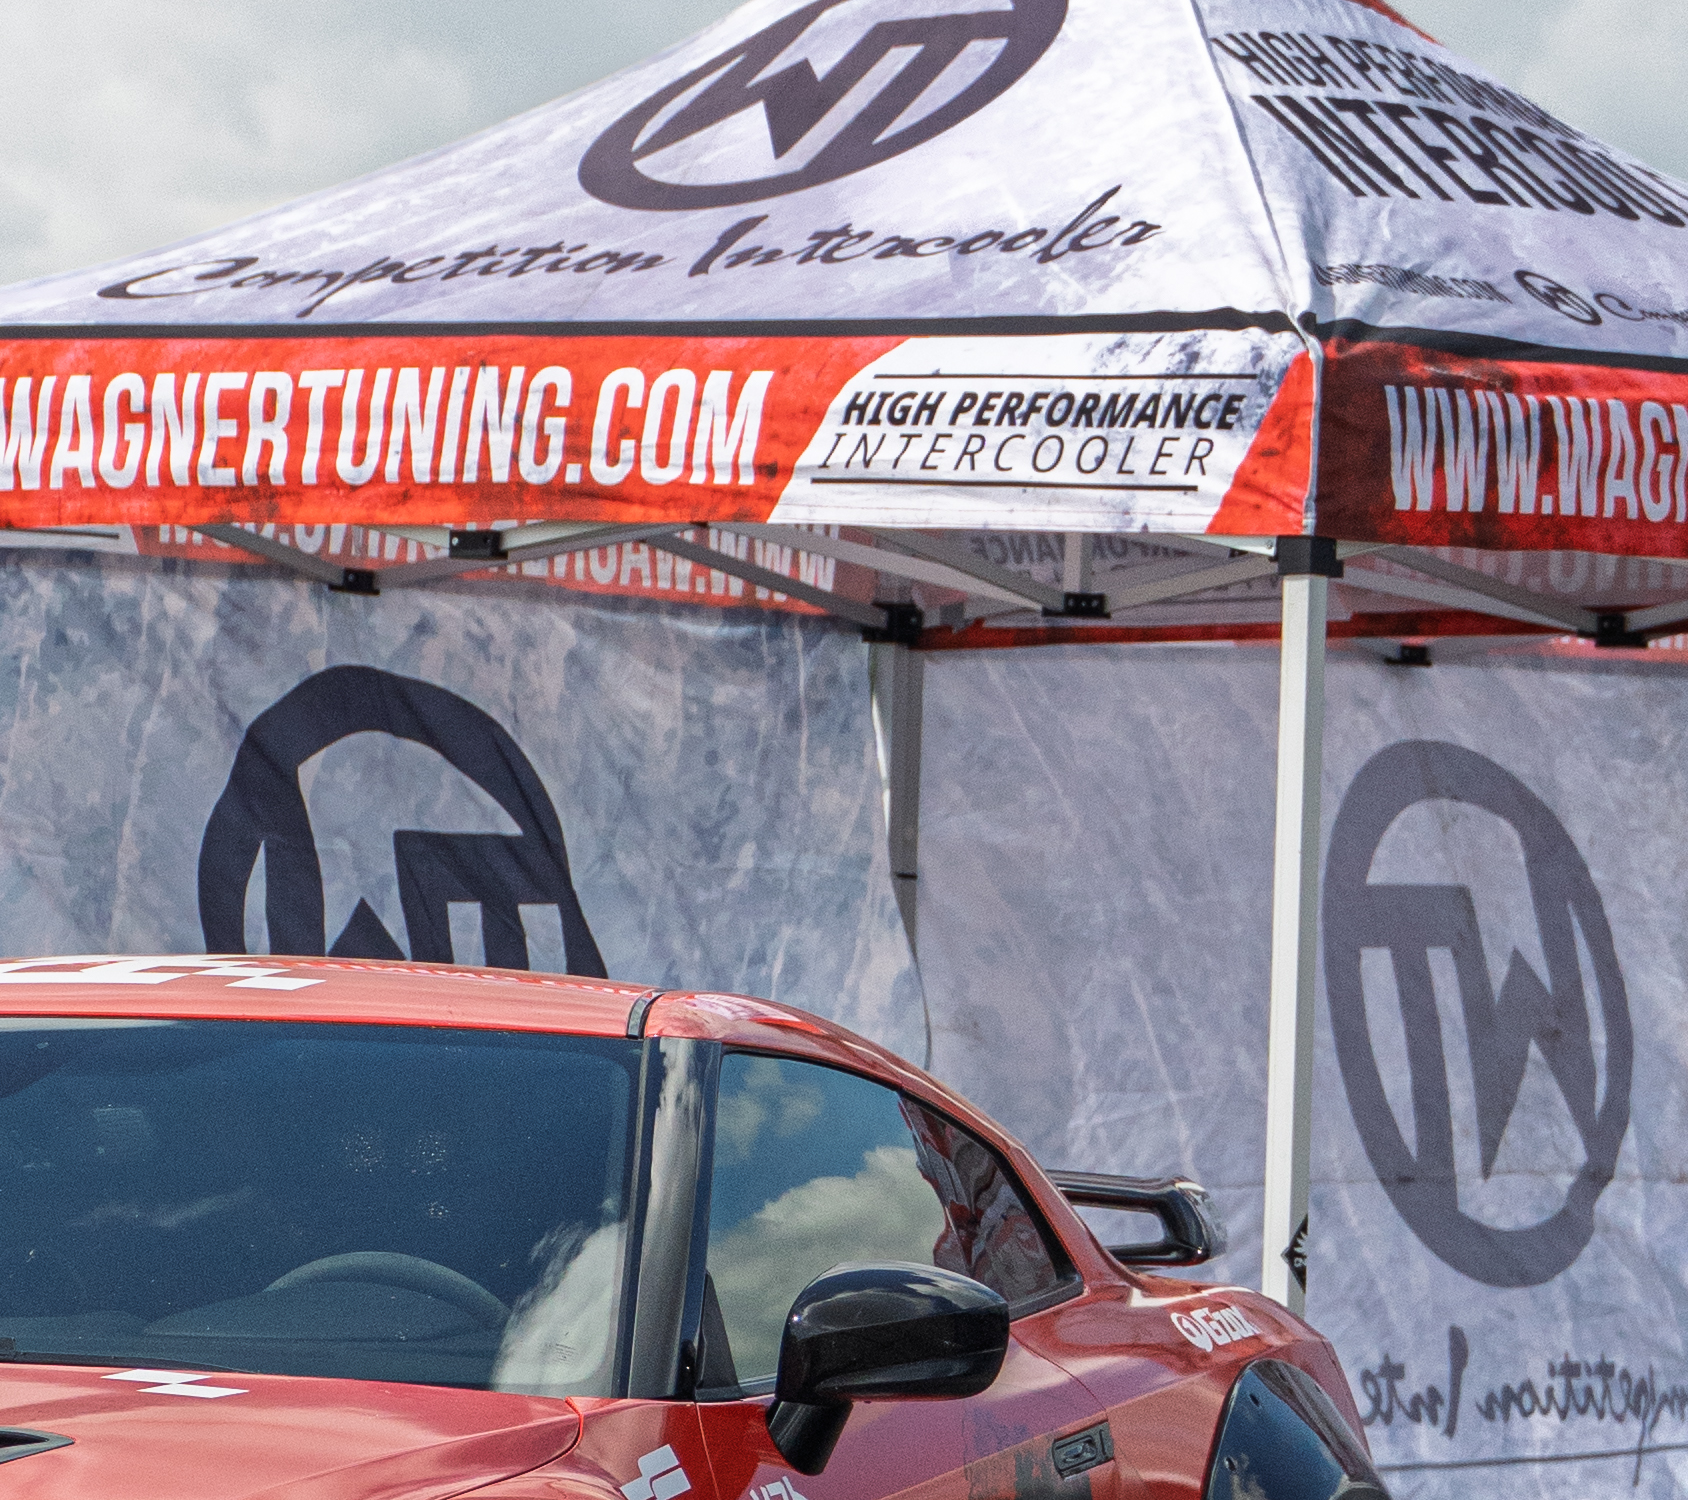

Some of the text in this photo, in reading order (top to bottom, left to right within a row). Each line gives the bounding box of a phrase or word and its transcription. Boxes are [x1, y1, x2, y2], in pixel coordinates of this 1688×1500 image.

[1212, 31, 1358, 90] HIGH
[96, 184, 1163, 317] Competition Intercooler
[841, 390, 1247, 430] HIGH PERFORMANCE
[817, 432, 1215, 477] INTERCOOLER
